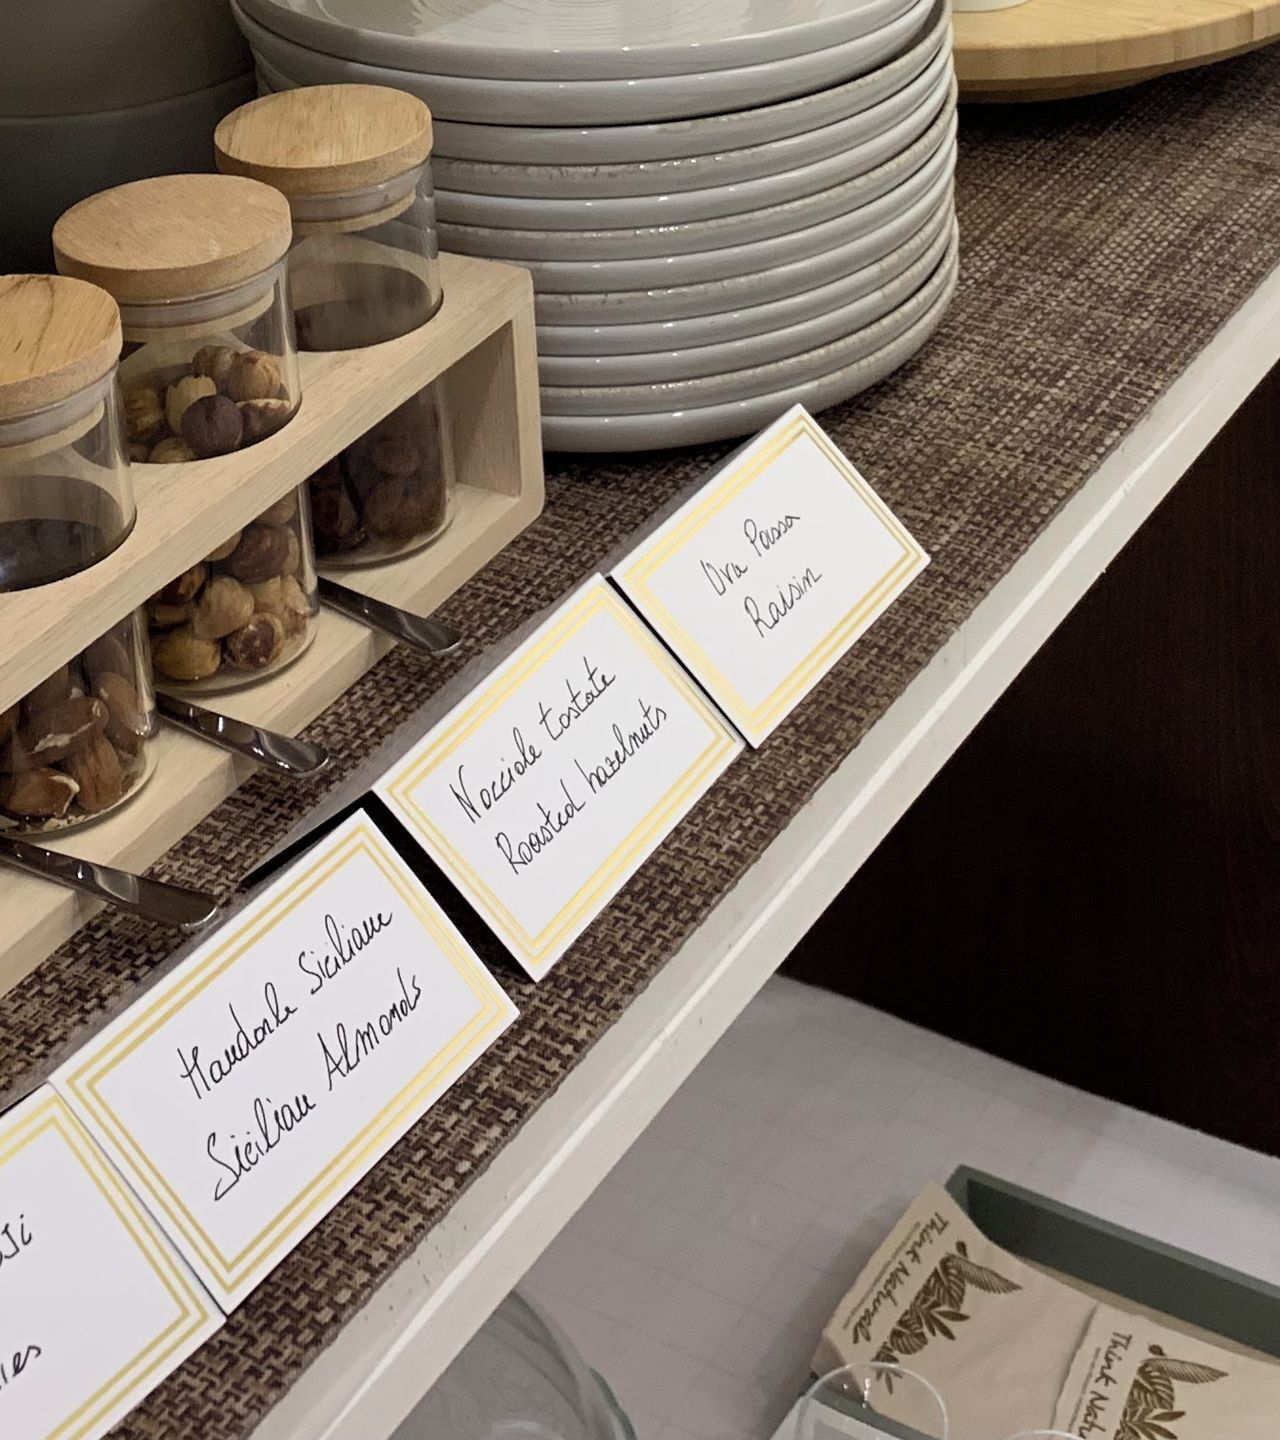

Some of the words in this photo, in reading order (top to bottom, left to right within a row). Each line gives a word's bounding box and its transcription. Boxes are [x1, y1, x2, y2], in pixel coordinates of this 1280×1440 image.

[699, 559, 749, 597] Uva
[743, 513, 801, 558] Passa
[742, 566, 823, 639] Raisin
[448, 725, 543, 825] Nocciole
[494, 777, 587, 876] Roasted
[573, 697, 668, 795] hazelnuts
[298, 913, 394, 996] Siciliane
[206, 1092, 317, 1203] Sicilian
[316, 966, 423, 1092] Almonds
[906, 1211, 950, 1265] Think
[852, 1260, 910, 1345] Natural
[1094, 1331, 1133, 1387] Think
[1078, 1390, 1110, 1440] Natu
